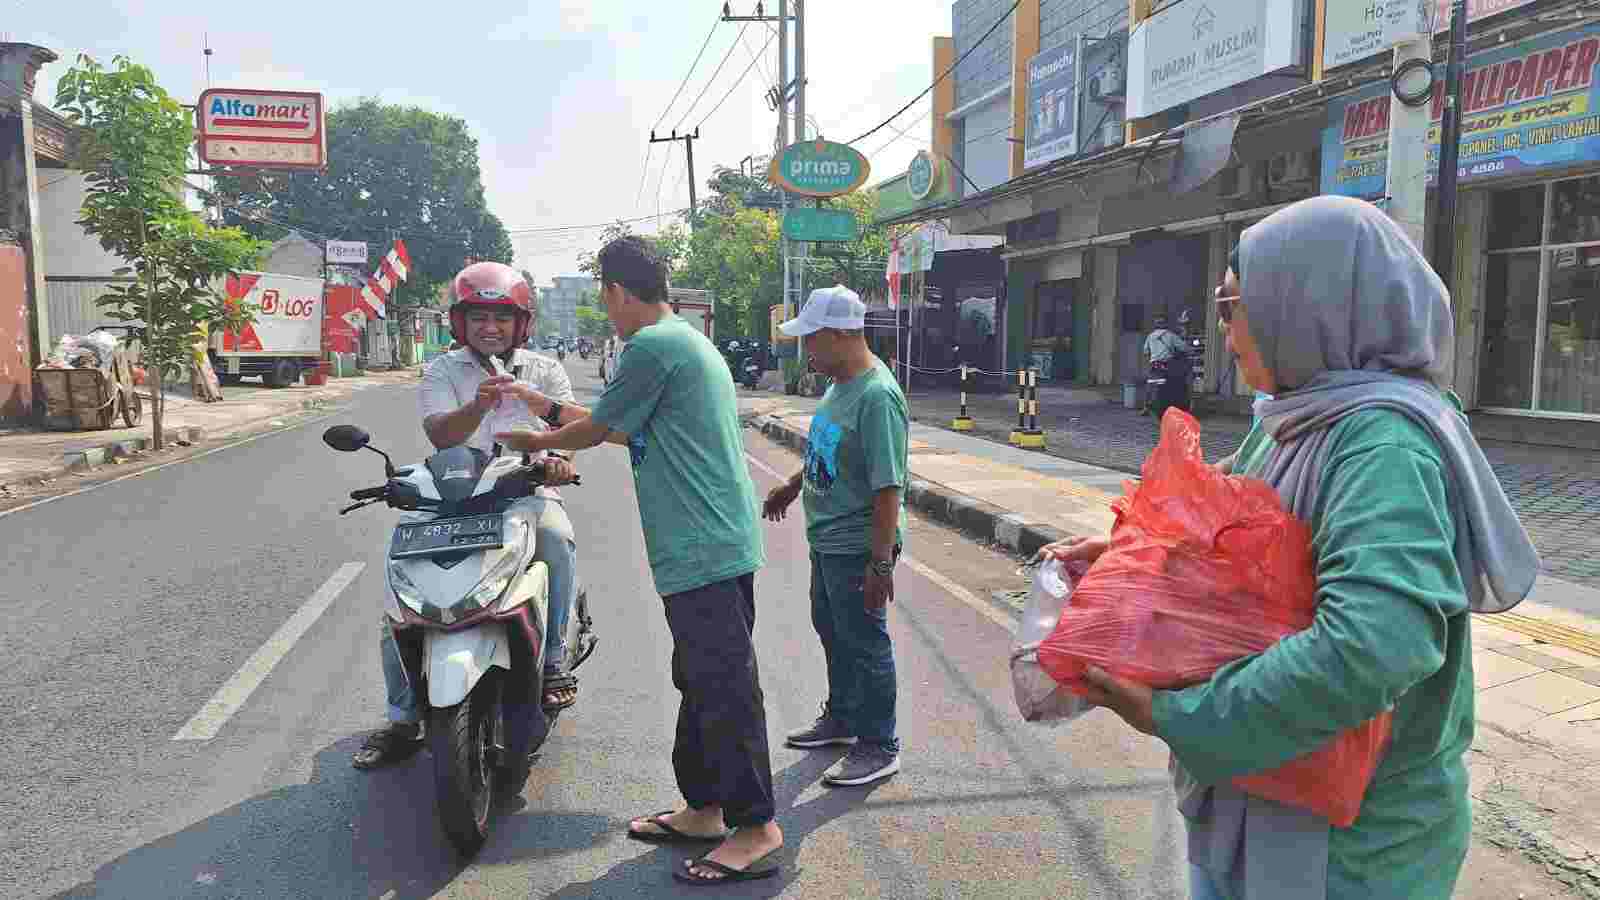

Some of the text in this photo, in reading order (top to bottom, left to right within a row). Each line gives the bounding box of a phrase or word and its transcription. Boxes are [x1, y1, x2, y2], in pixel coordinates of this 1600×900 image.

[1151, 50, 1198, 89] RUMAH
[1203, 25, 1258, 66] MUSLIM
[210, 97, 310, 119] Alfamart
[1511, 99, 1574, 122] STOCK
[791, 158, 851, 177] prima
